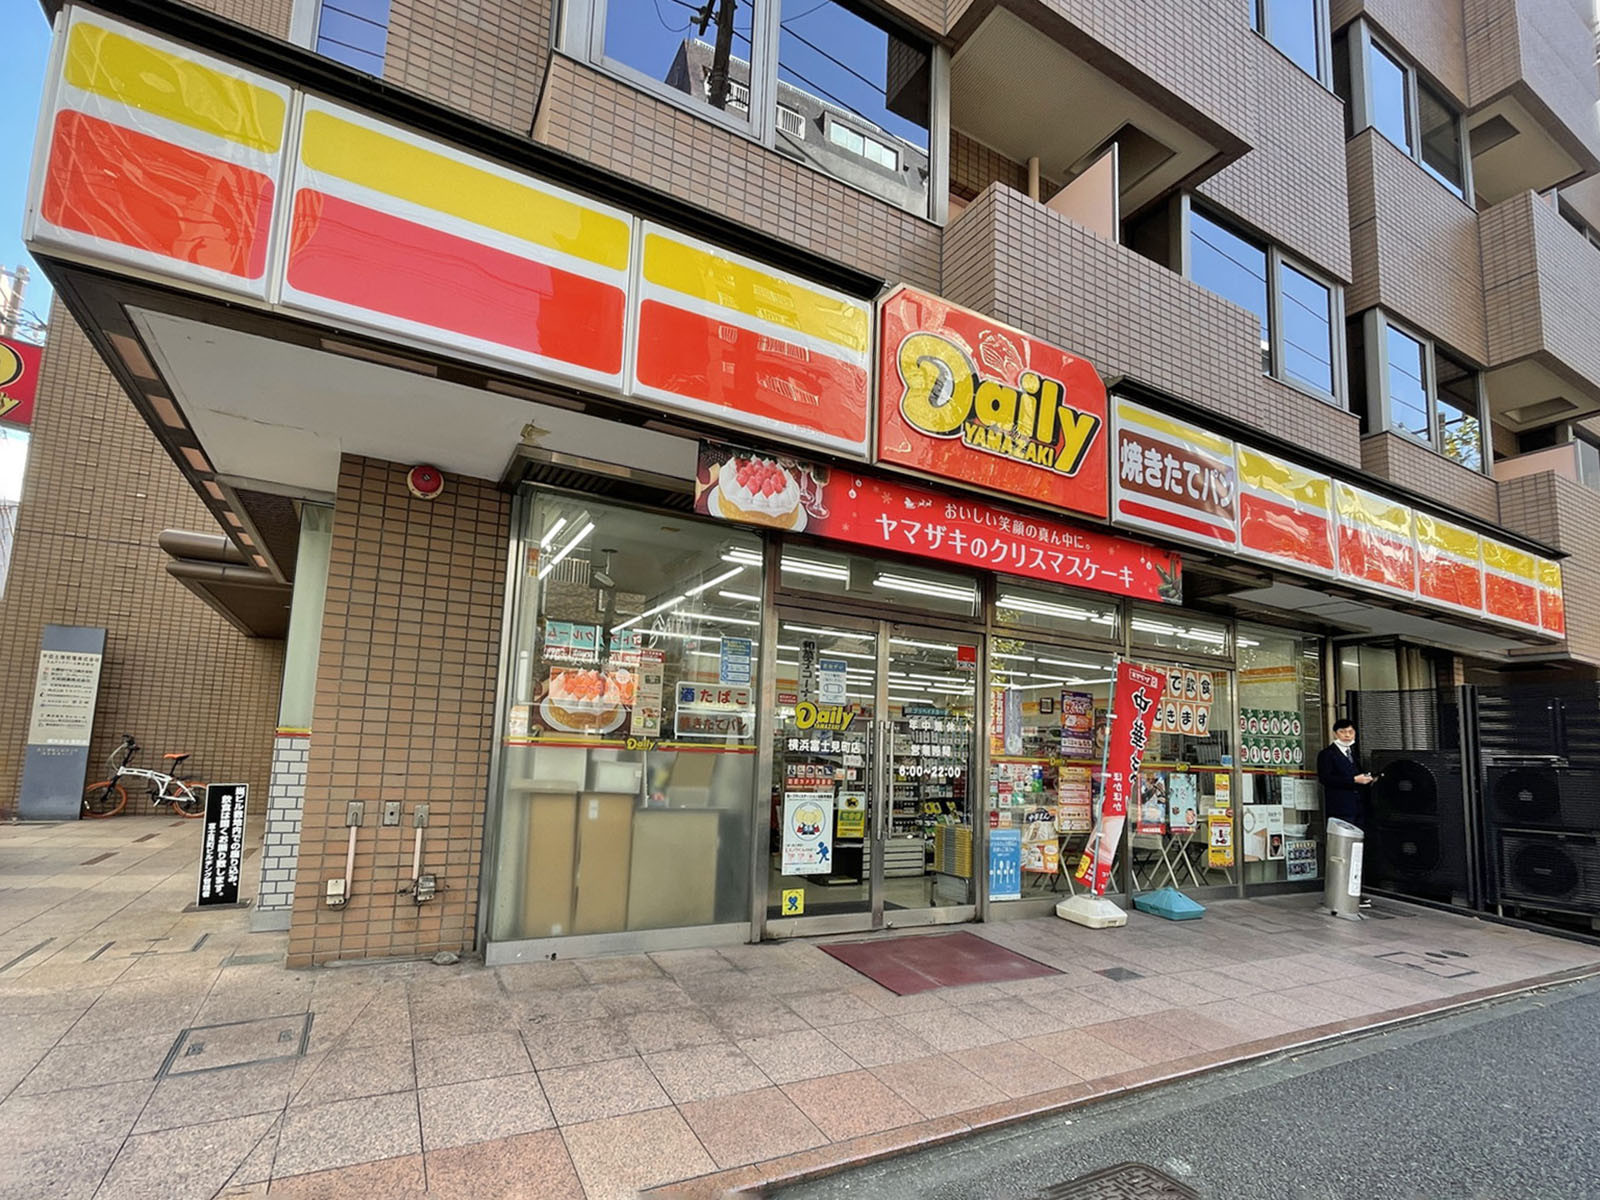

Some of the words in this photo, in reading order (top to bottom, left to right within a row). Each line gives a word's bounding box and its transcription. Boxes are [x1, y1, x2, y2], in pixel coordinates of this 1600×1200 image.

[898, 333, 1100, 475] Daily
[964, 422, 1056, 468] YAMAZAKI
[1120, 437, 1235, 508] 焼きたてパン
[875, 512, 1134, 588] ヤマザキのクリスマスケーキ
[944, 502, 1093, 551] おいしい笑顔の真ん中に。
[799, 640, 817, 702] 和菓子コーナ
[681, 687, 695, 703] 酒
[700, 688, 748, 706] たばこ
[795, 701, 856, 731] Daily
[788, 738, 862, 754] 横浜富士見町店
[909, 720, 958, 733] 年中無休
